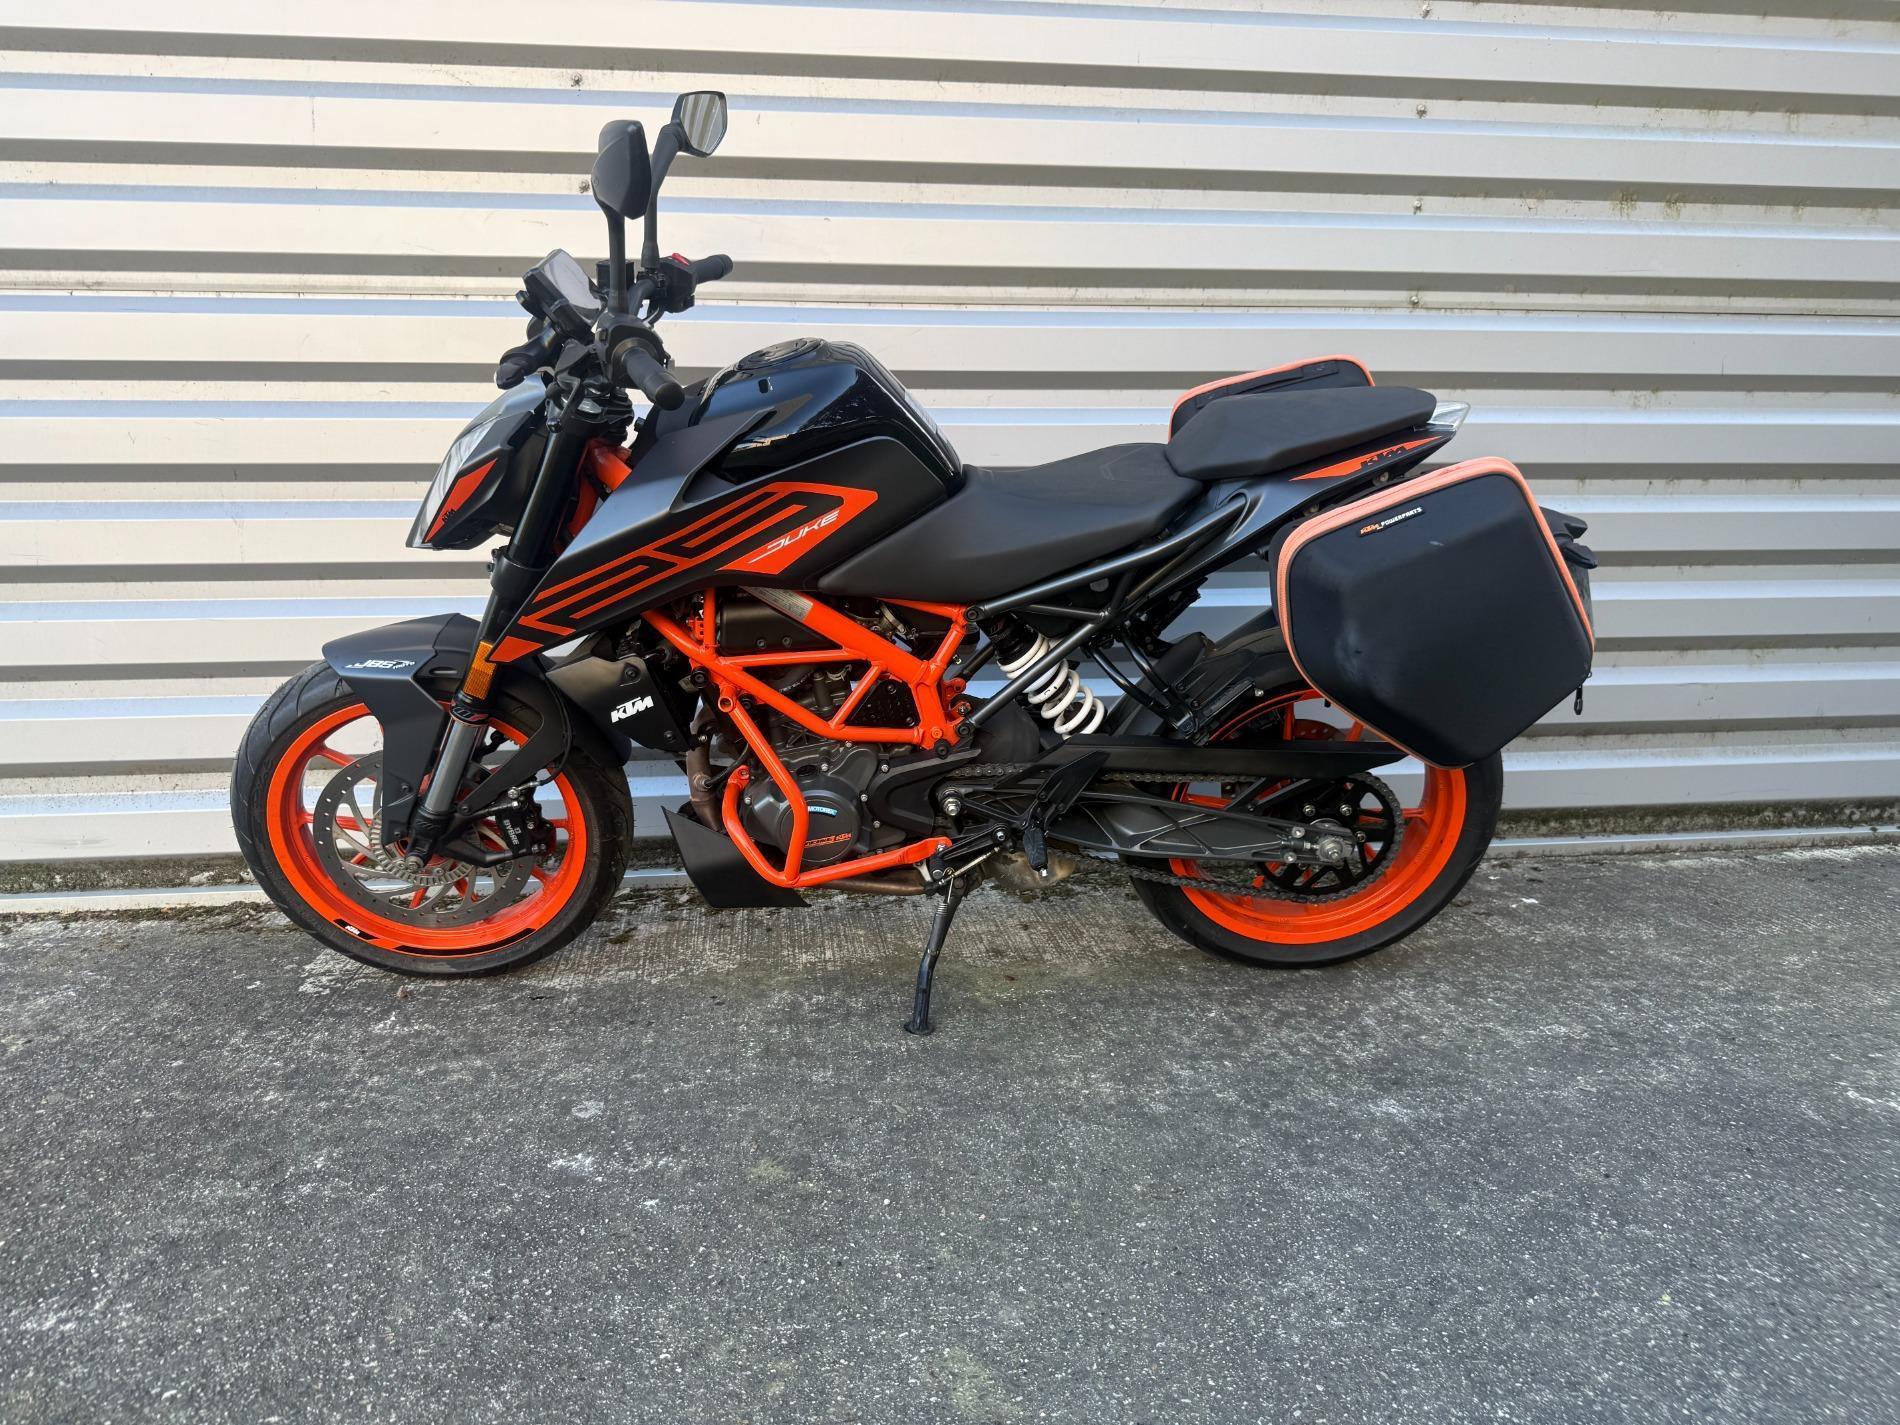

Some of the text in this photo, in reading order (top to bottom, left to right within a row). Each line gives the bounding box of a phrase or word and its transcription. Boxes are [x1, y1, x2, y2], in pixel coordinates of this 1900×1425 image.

[1380, 507, 1423, 526] POWERPARTS
[747, 510, 840, 564] DUKE
[610, 695, 654, 723] KTM
[503, 819, 520, 845] BYBRE
[344, 925, 361, 936] KTM
